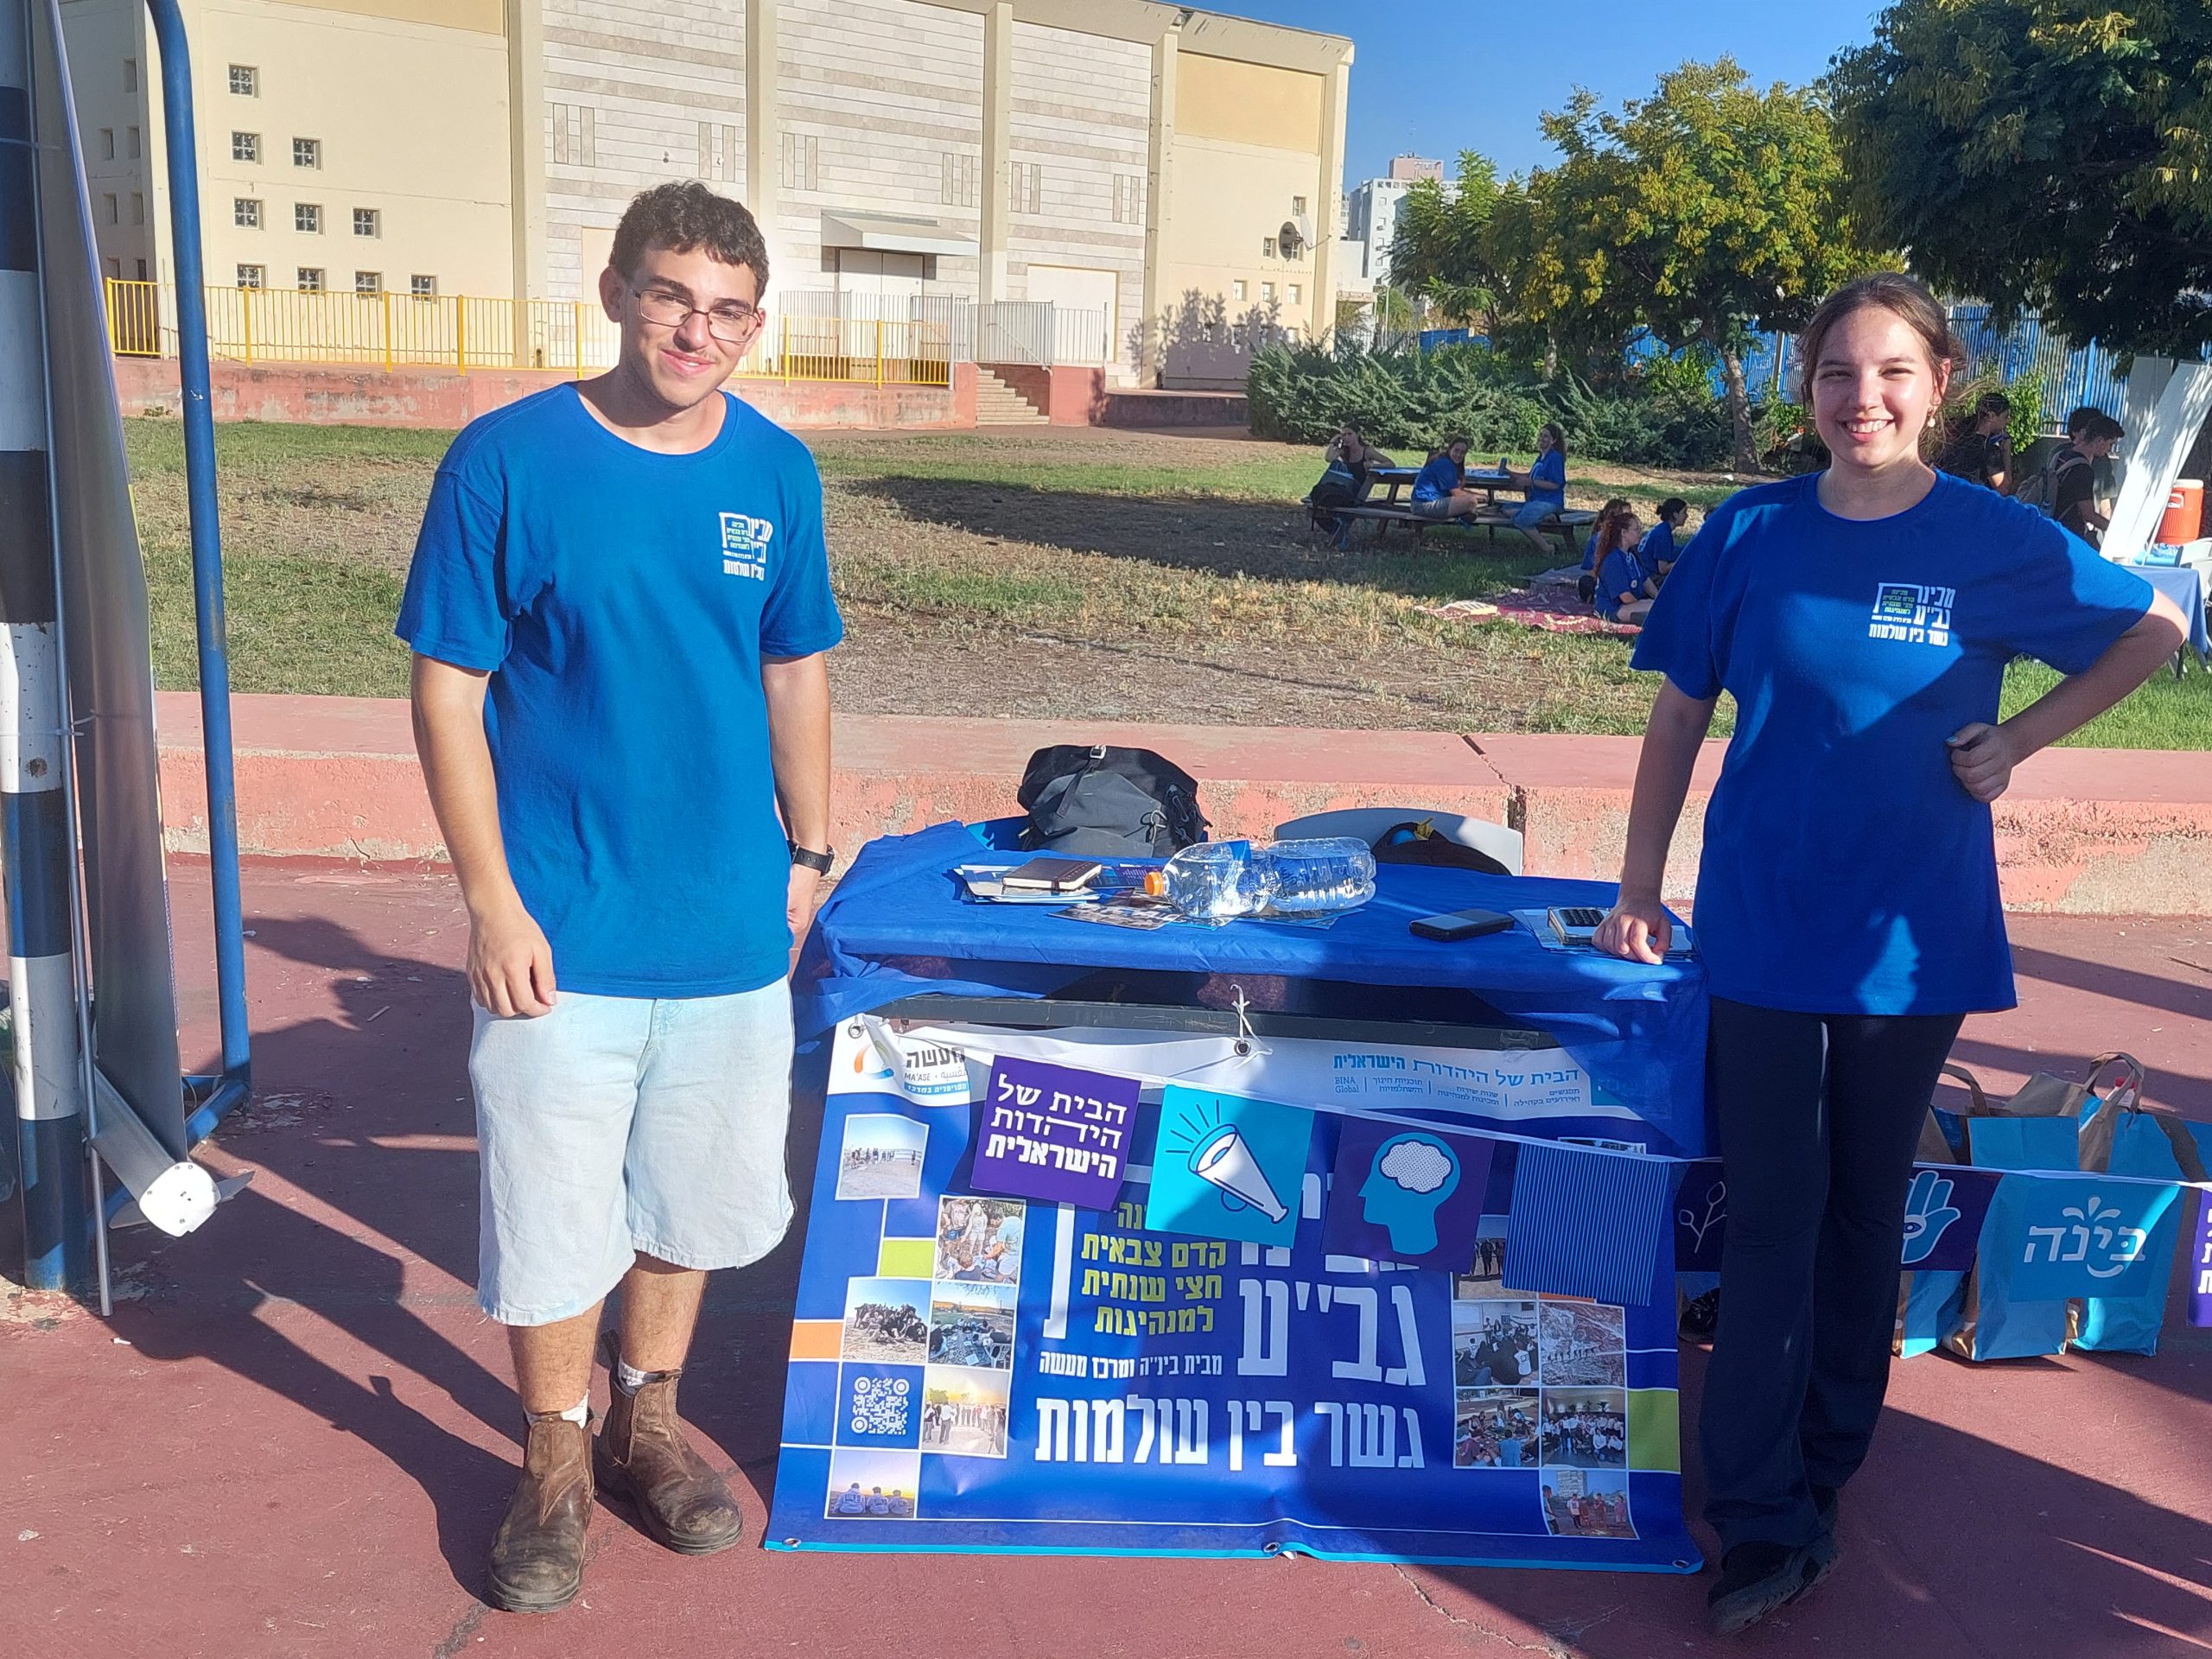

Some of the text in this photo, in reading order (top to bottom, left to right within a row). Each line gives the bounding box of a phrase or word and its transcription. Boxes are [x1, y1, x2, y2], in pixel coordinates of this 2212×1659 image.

[1868, 623, 1907, 640] עולמות
[1908, 627, 1924, 643] בין
[1333, 1052, 1405, 1070] הישראלית
[1413, 1058, 1488, 1084] היהדות
[997, 1072, 1042, 1105] של
[1335, 1084, 1359, 1093] Global
[1495, 1067, 1524, 1086] של
[1529, 1068, 1579, 1085] הבית
[1049, 1090, 1128, 1124] הבית
[990, 1106, 1122, 1149] היהדות
[985, 1133, 1117, 1179] הישראלית
[1081, 1233, 1226, 1268] קדם צבאית
[2024, 1224, 2146, 1262] בינה
[1082, 1268, 1222, 1302] חצי שנתית
[1094, 1305, 1214, 1337] למנהיגות
[1039, 1351, 1087, 1377] מעשה
[1091, 1357, 1135, 1379] ומרכז
[1184, 1355, 1222, 1376] מבית
[1035, 1394, 1426, 1471] גשר בין עולמות
